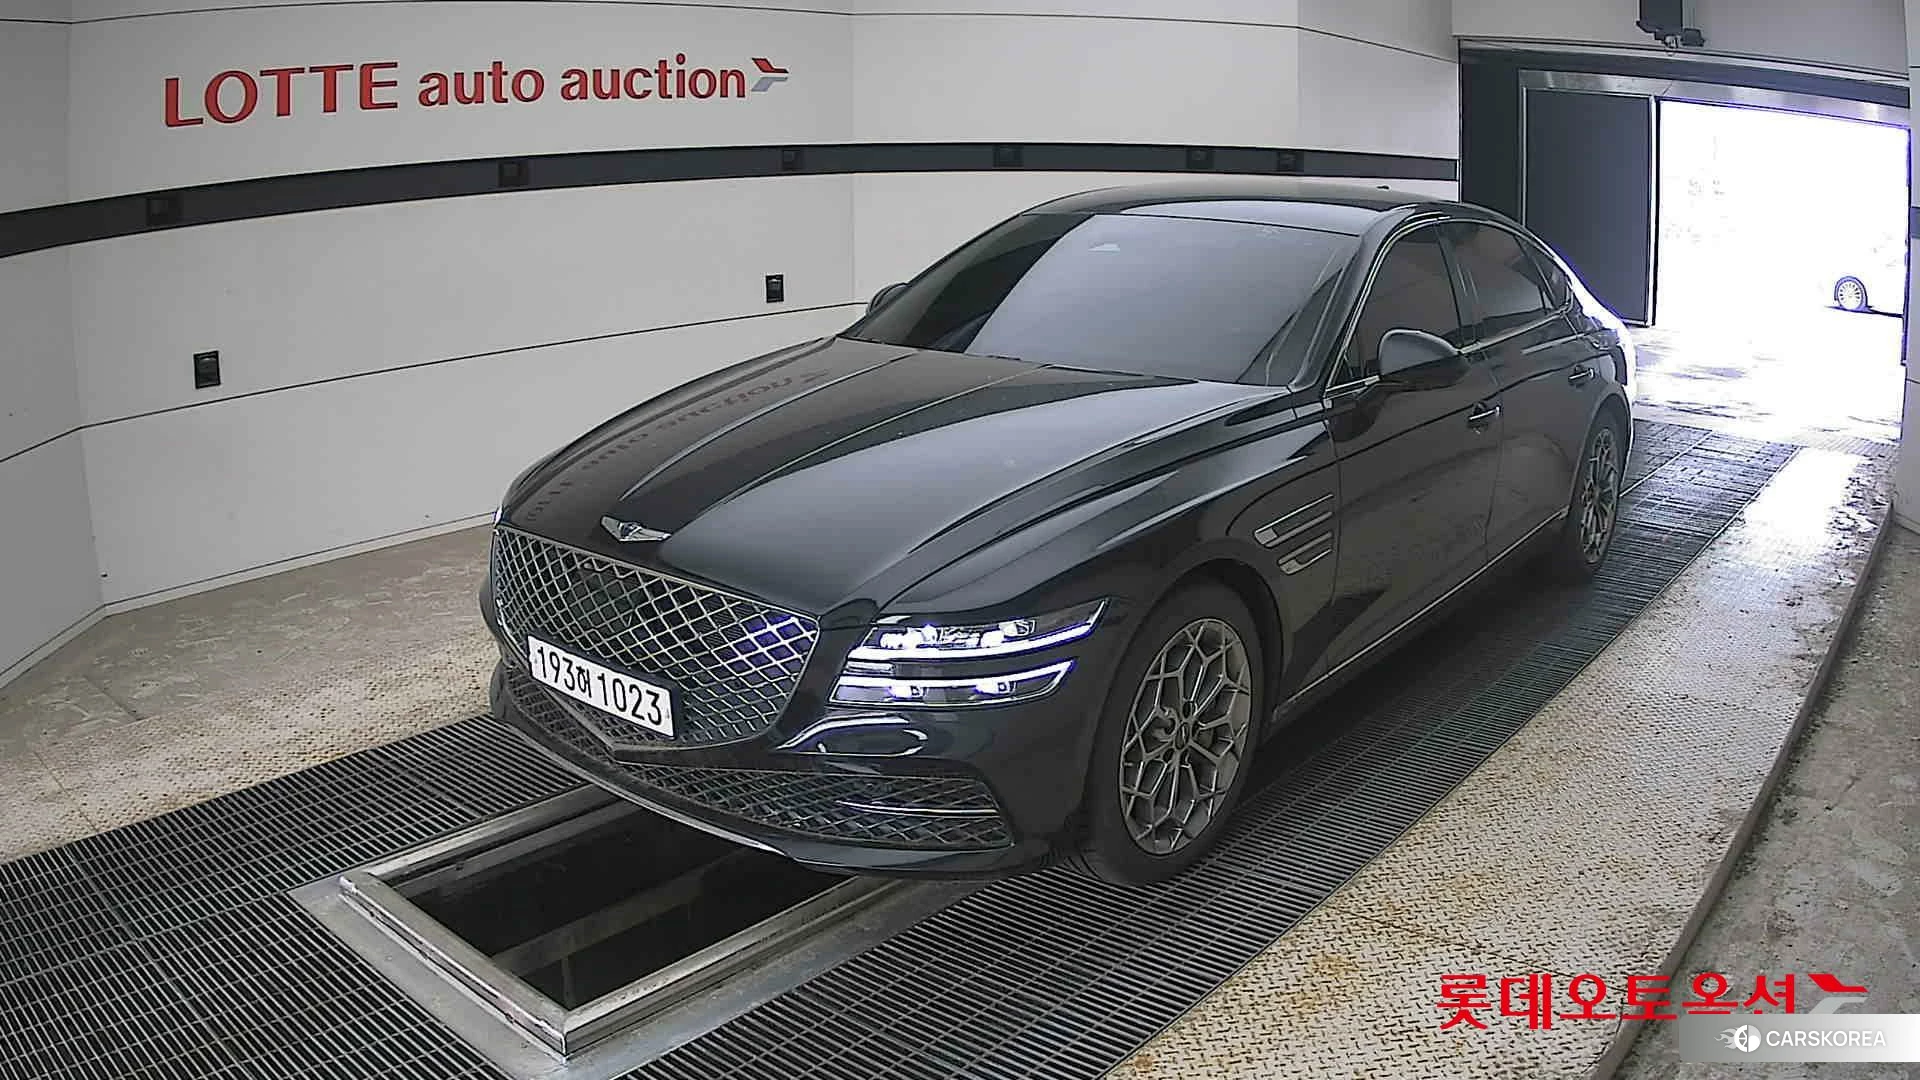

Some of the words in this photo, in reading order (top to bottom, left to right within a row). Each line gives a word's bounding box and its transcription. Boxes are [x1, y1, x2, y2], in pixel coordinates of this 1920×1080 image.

[164, 63, 400, 127] LOTTE
[418, 61, 545, 107] auto
[560, 54, 746, 101] auction
[597, 673, 662, 726] 1023
